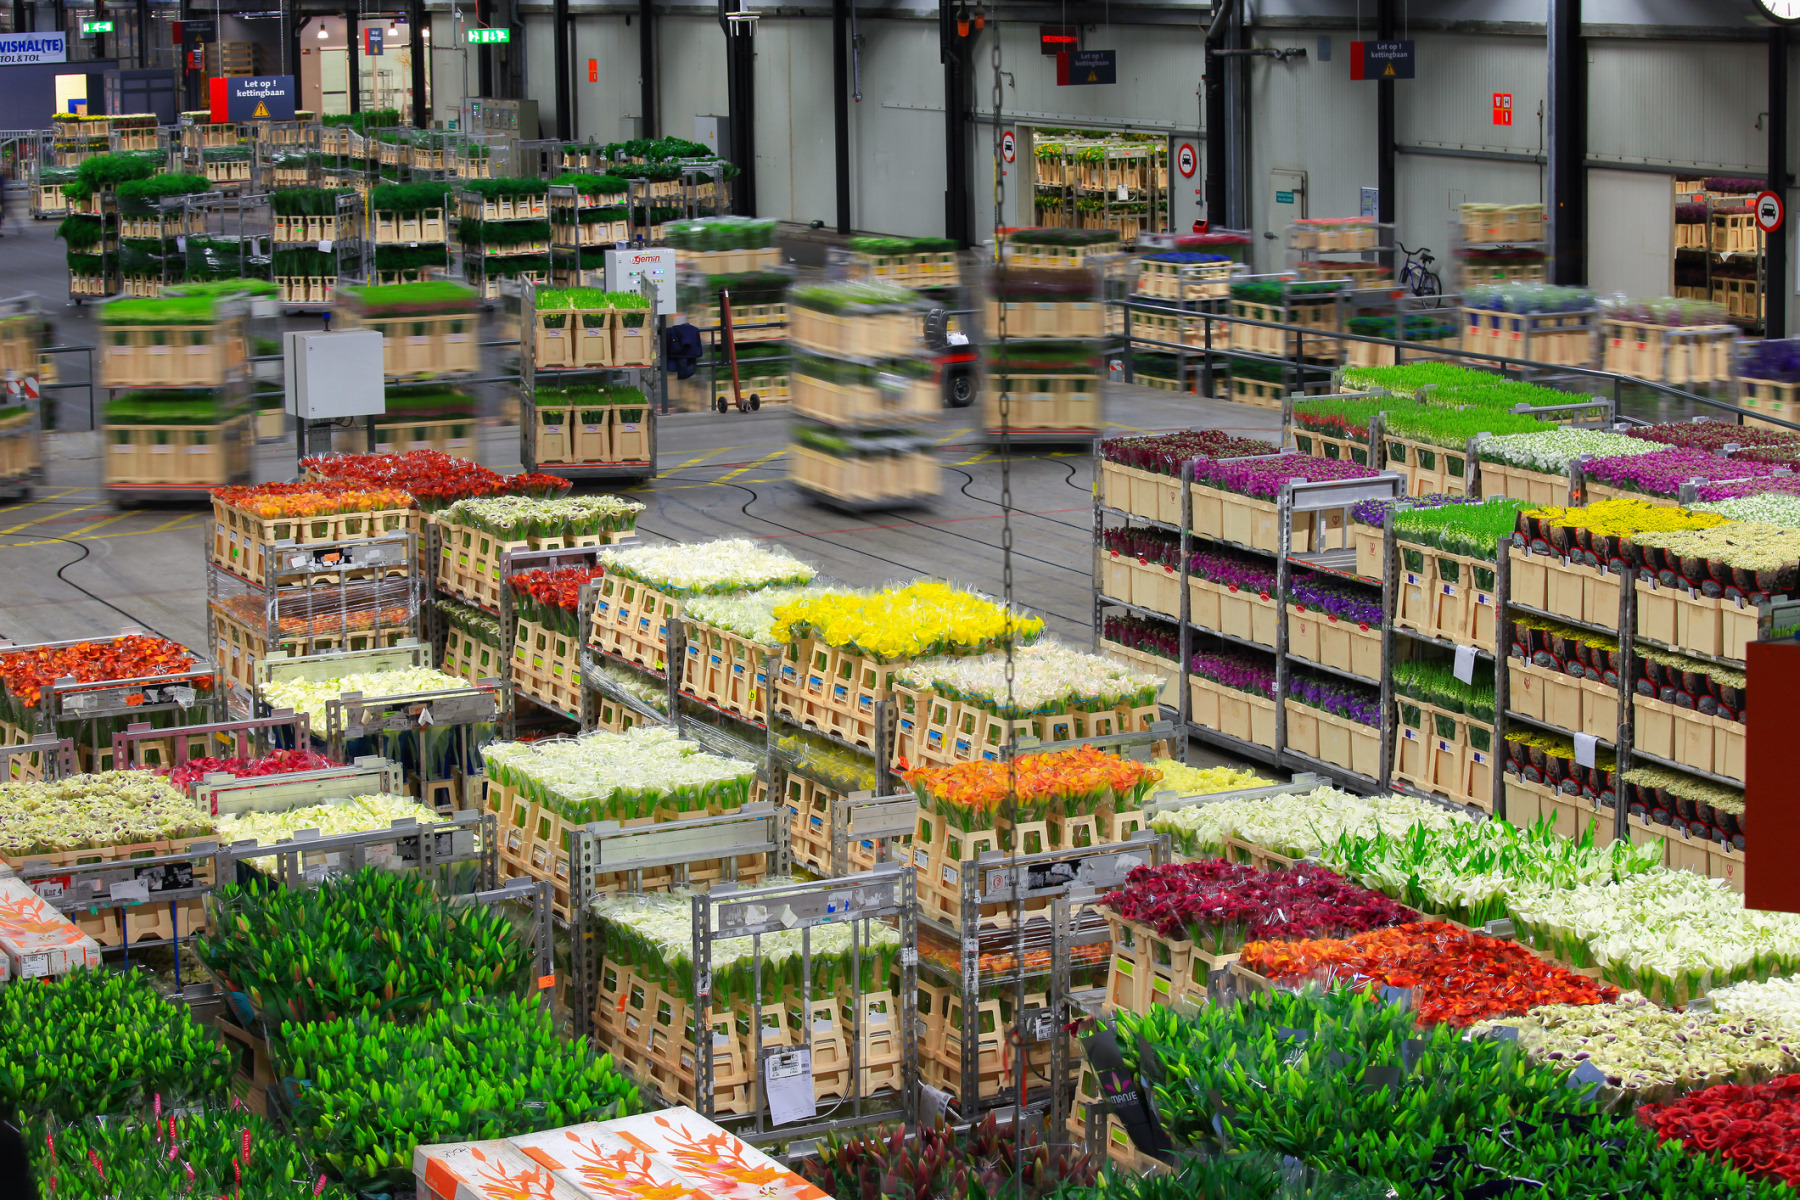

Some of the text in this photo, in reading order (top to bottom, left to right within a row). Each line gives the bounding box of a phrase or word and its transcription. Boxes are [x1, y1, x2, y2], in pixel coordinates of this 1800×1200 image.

[24, 54, 41, 62] TOL
[245, 80, 258, 88] Let
[260, 81, 271, 90] op
[237, 89, 285, 98] kettingbaan
